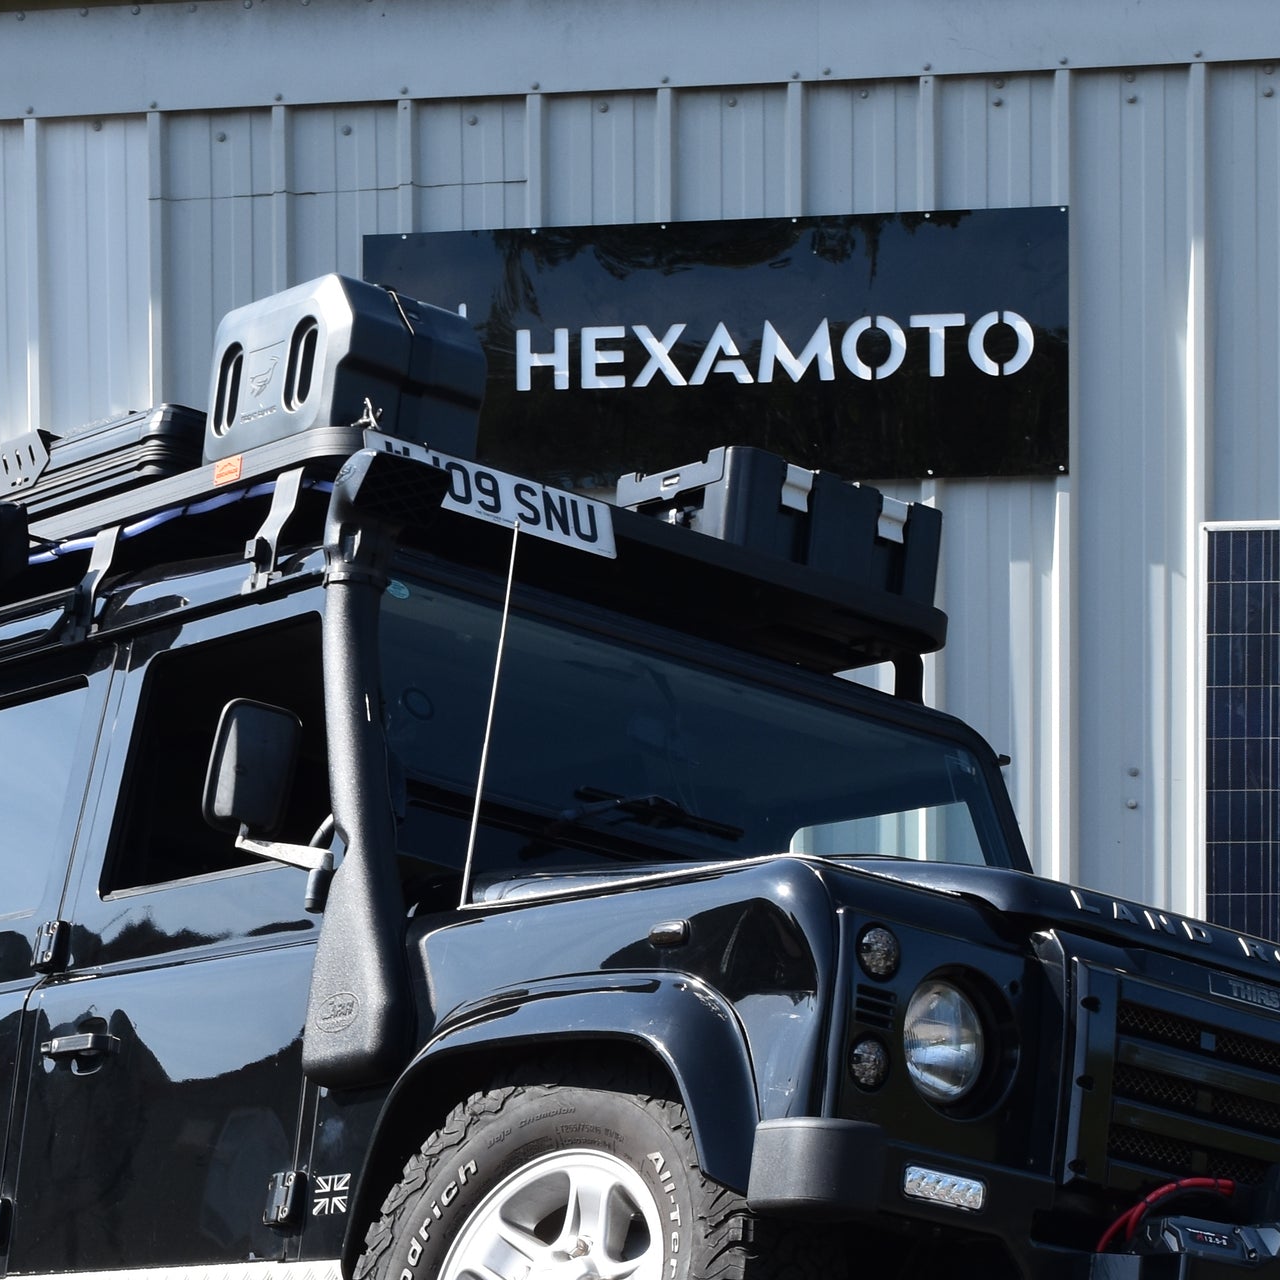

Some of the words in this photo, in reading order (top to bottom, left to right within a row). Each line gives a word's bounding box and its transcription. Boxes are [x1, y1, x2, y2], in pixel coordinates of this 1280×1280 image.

[516, 310, 1035, 392] HEXAMOTO
[513, 483, 599, 543] SNU
[1070, 889, 1213, 945] LAND
